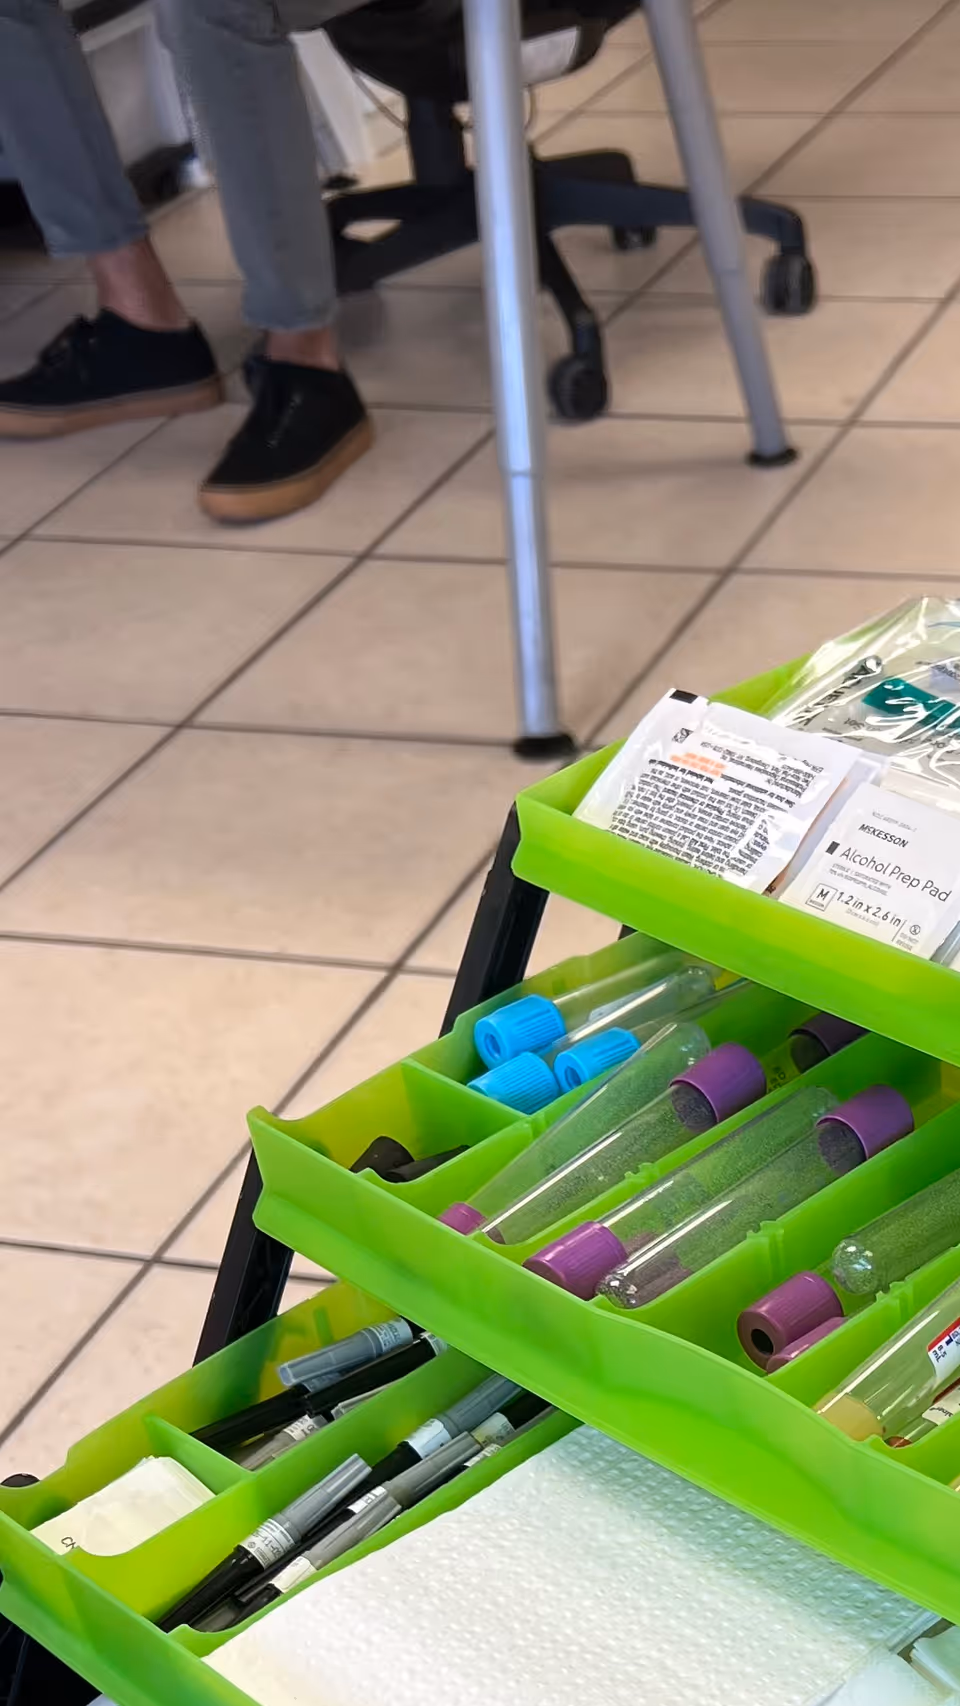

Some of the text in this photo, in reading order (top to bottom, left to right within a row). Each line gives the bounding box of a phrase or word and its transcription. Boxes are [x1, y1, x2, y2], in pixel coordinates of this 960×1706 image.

[840, 847, 952, 902] Alcohol Prep Pad
[817, 888, 830, 901] M
[837, 891, 853, 905] 1.2
[853, 898, 863, 910] in
[864, 905, 873, 914] x
[872, 907, 890, 921] 2.6
[890, 914, 902, 927] in
